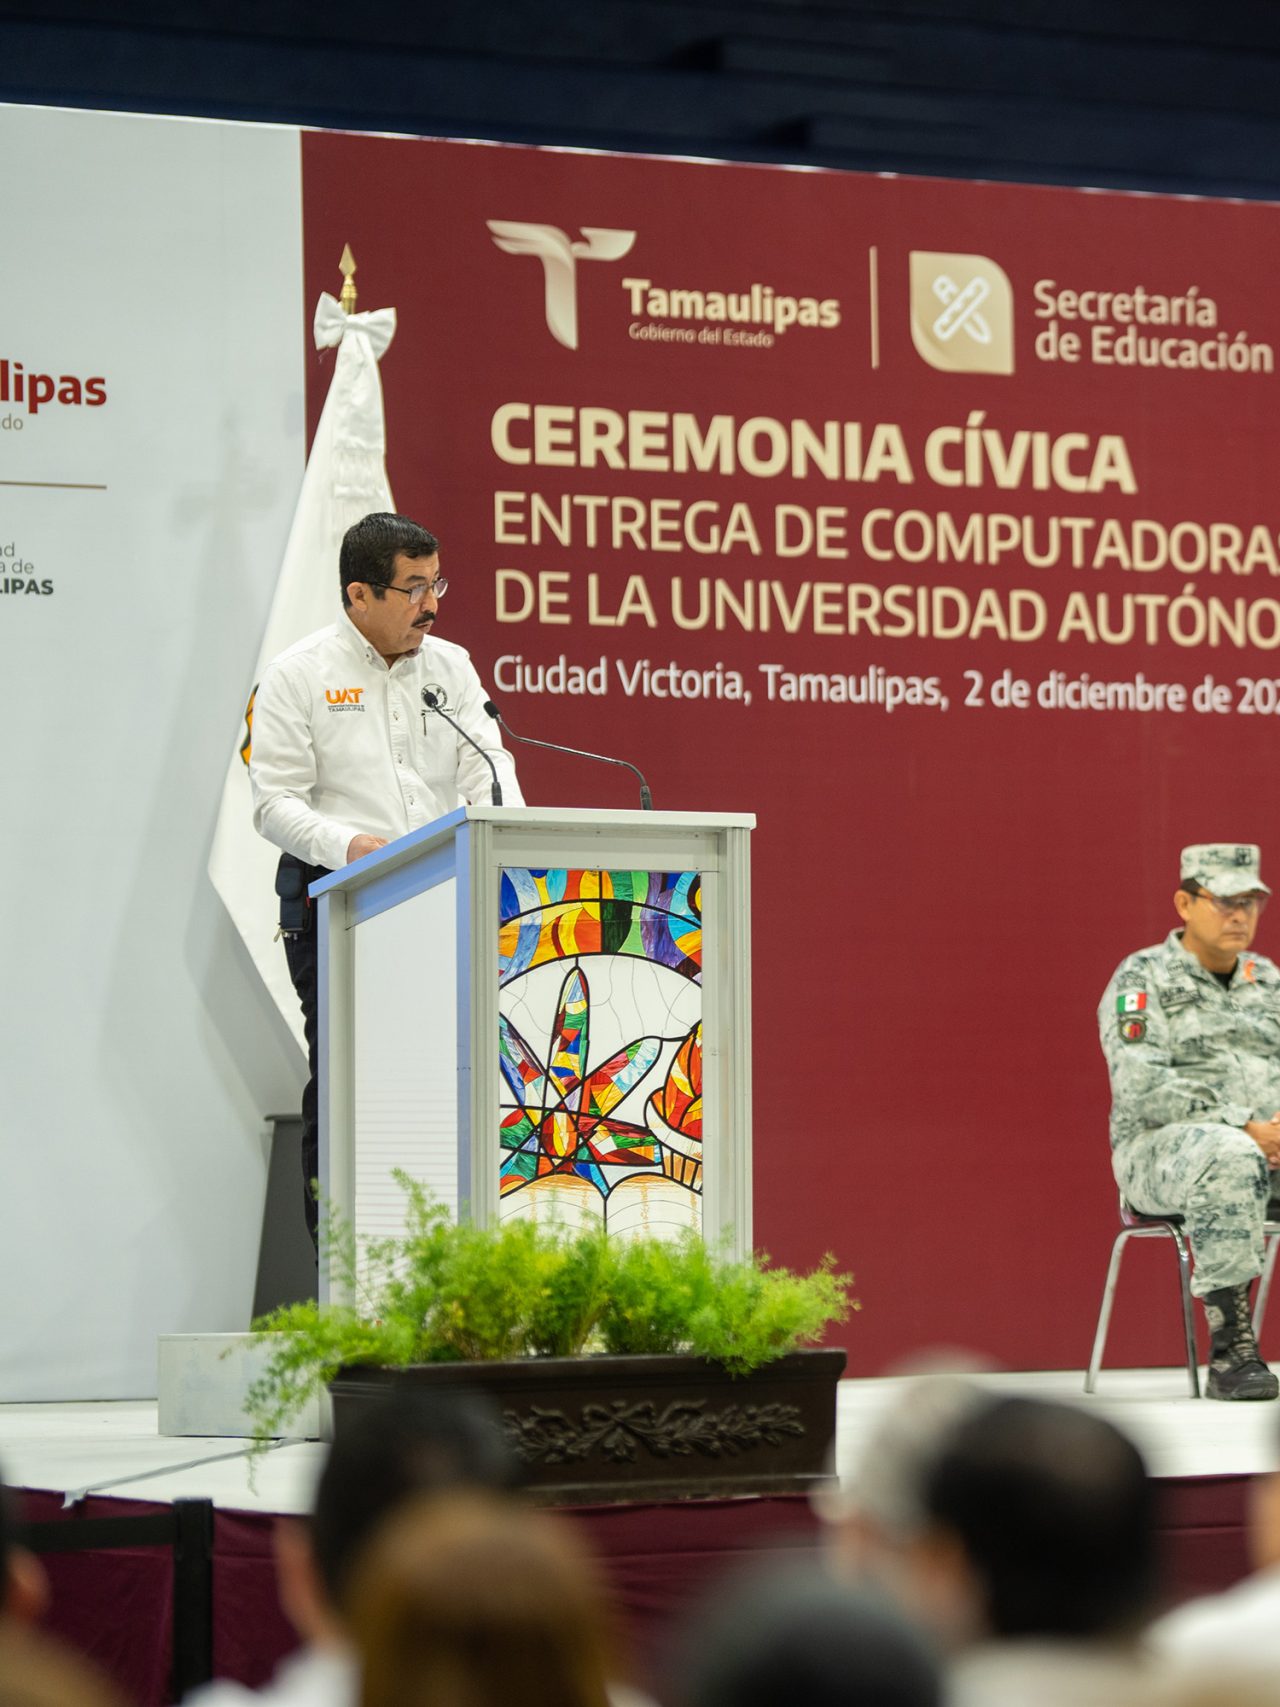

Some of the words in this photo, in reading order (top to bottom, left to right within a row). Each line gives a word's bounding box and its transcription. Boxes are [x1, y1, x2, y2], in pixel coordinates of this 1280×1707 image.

[622, 278, 841, 334] Tamaulipas
[1033, 279, 1218, 328] Secretaría
[628, 322, 696, 343] Gobierno
[698, 326, 722, 344] del
[723, 328, 775, 348] Estado
[1034, 322, 1081, 362] de
[1091, 326, 1274, 374] Educación
[490, 402, 914, 484] CEREMONIA
[925, 410, 1138, 495] CÍVICA
[494, 490, 761, 557] ENTREGA
[774, 503, 849, 560] DE
[0, 577, 54, 595] IPAS
[494, 568, 572, 625] DE
[587, 572, 657, 629] LA
[670, 576, 1048, 642] UNIVERSIDAD
[325, 687, 364, 704] UAT
[493, 656, 607, 694] Ciudad
[616, 658, 752, 704] Victoria,
[758, 663, 949, 712] Tamaulipas,
[962, 670, 985, 706] 2
[990, 669, 1030, 708] de
[1036, 671, 1187, 712] diciembre
[1192, 674, 1233, 713] de
